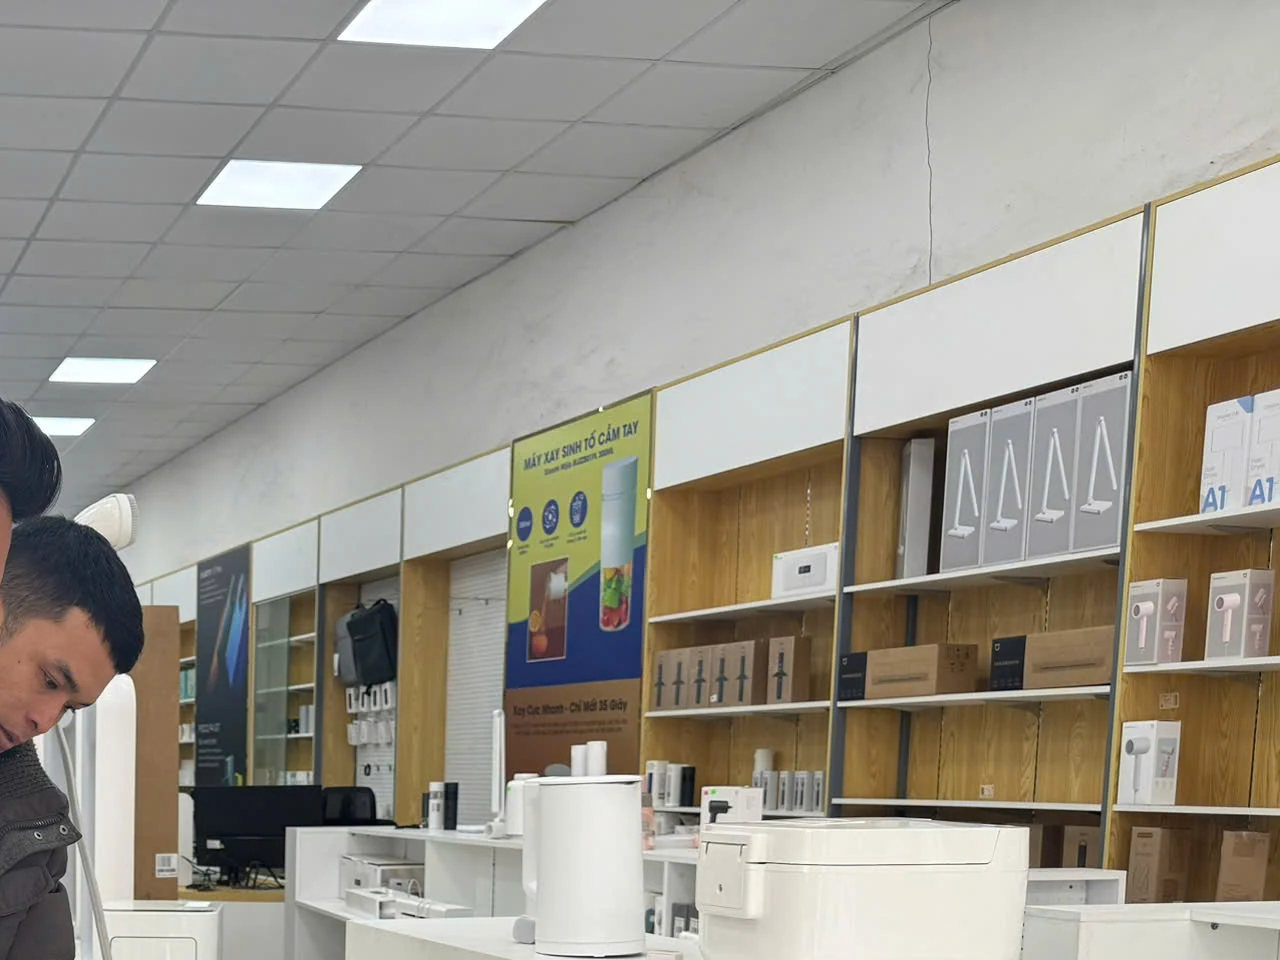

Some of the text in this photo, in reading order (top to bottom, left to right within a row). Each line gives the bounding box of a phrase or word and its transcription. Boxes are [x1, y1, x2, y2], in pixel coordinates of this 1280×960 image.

[524, 452, 541, 470] MÁY
[544, 448, 560, 464] XAY
[562, 440, 582, 458] SINH
[584, 430, 596, 450] TỐ
[623, 420, 638, 437] TAY
[1202, 485, 1226, 514] A1
[1249, 477, 1274, 506] A1
[598, 701, 608, 712] 35
